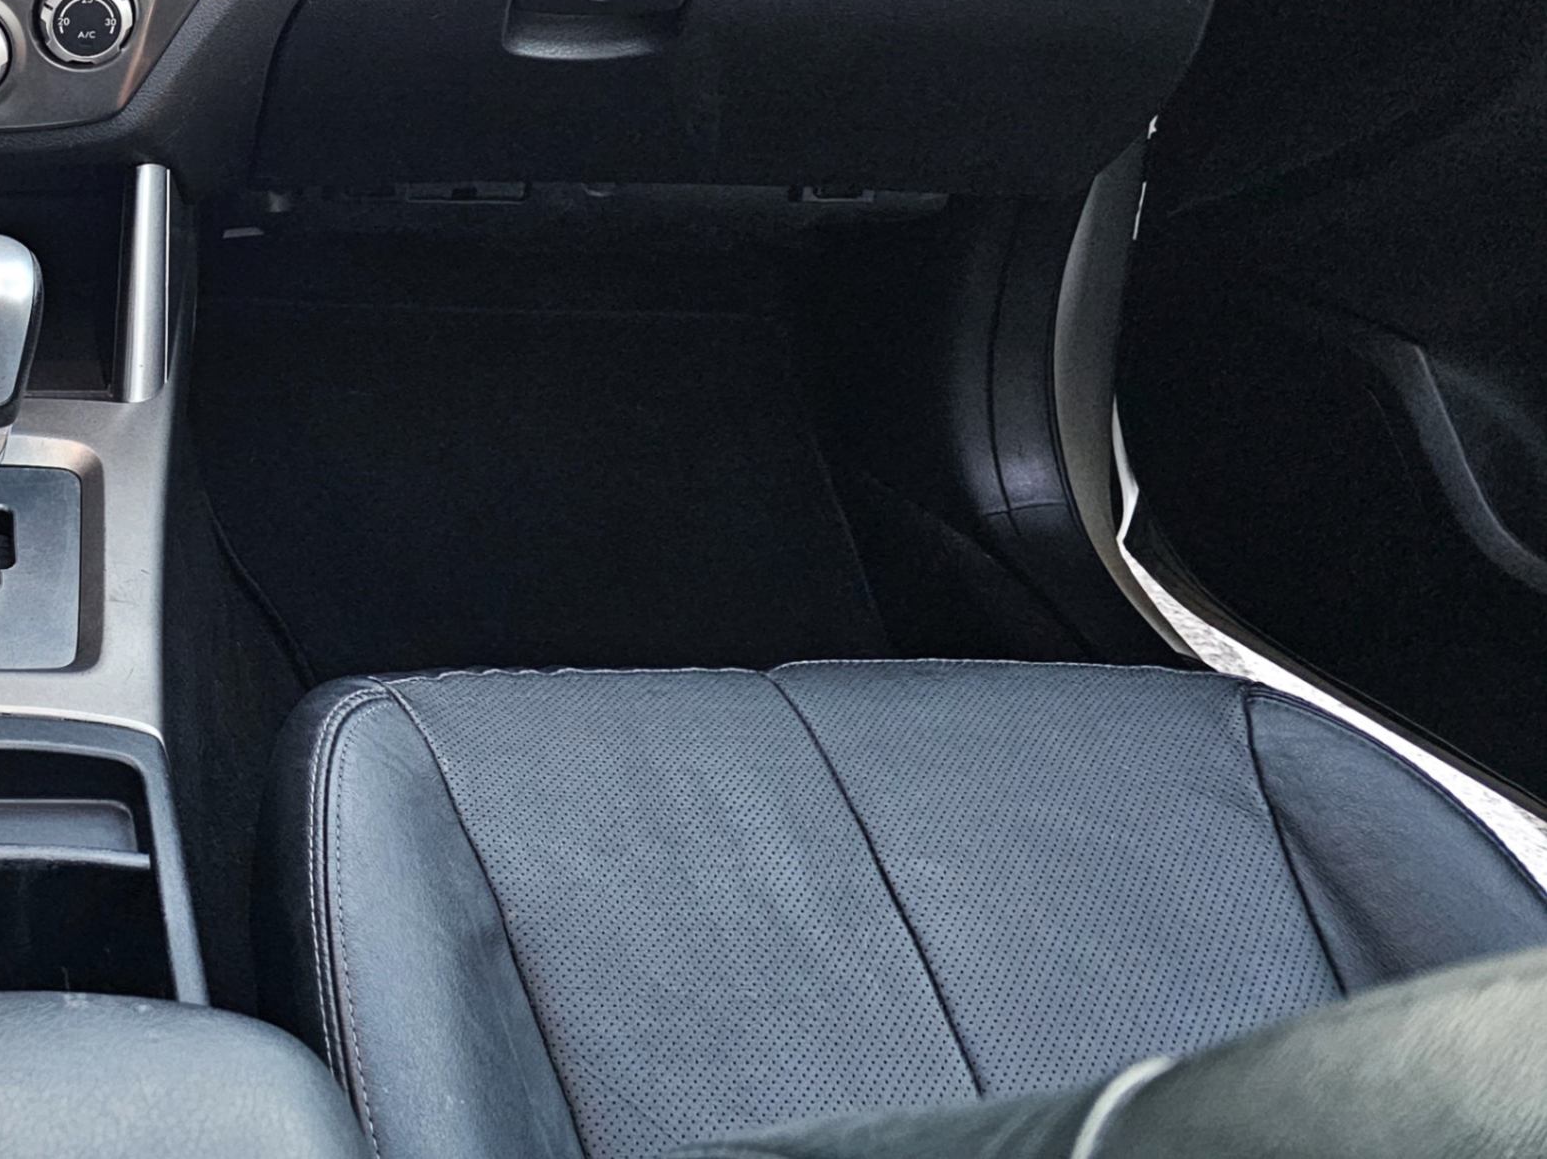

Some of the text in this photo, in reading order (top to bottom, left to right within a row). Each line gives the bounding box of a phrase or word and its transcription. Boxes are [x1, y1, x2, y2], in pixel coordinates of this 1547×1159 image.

[57, 17, 70, 26] 20
[104, 18, 117, 26] 30
[77, 31, 96, 39] A/C
